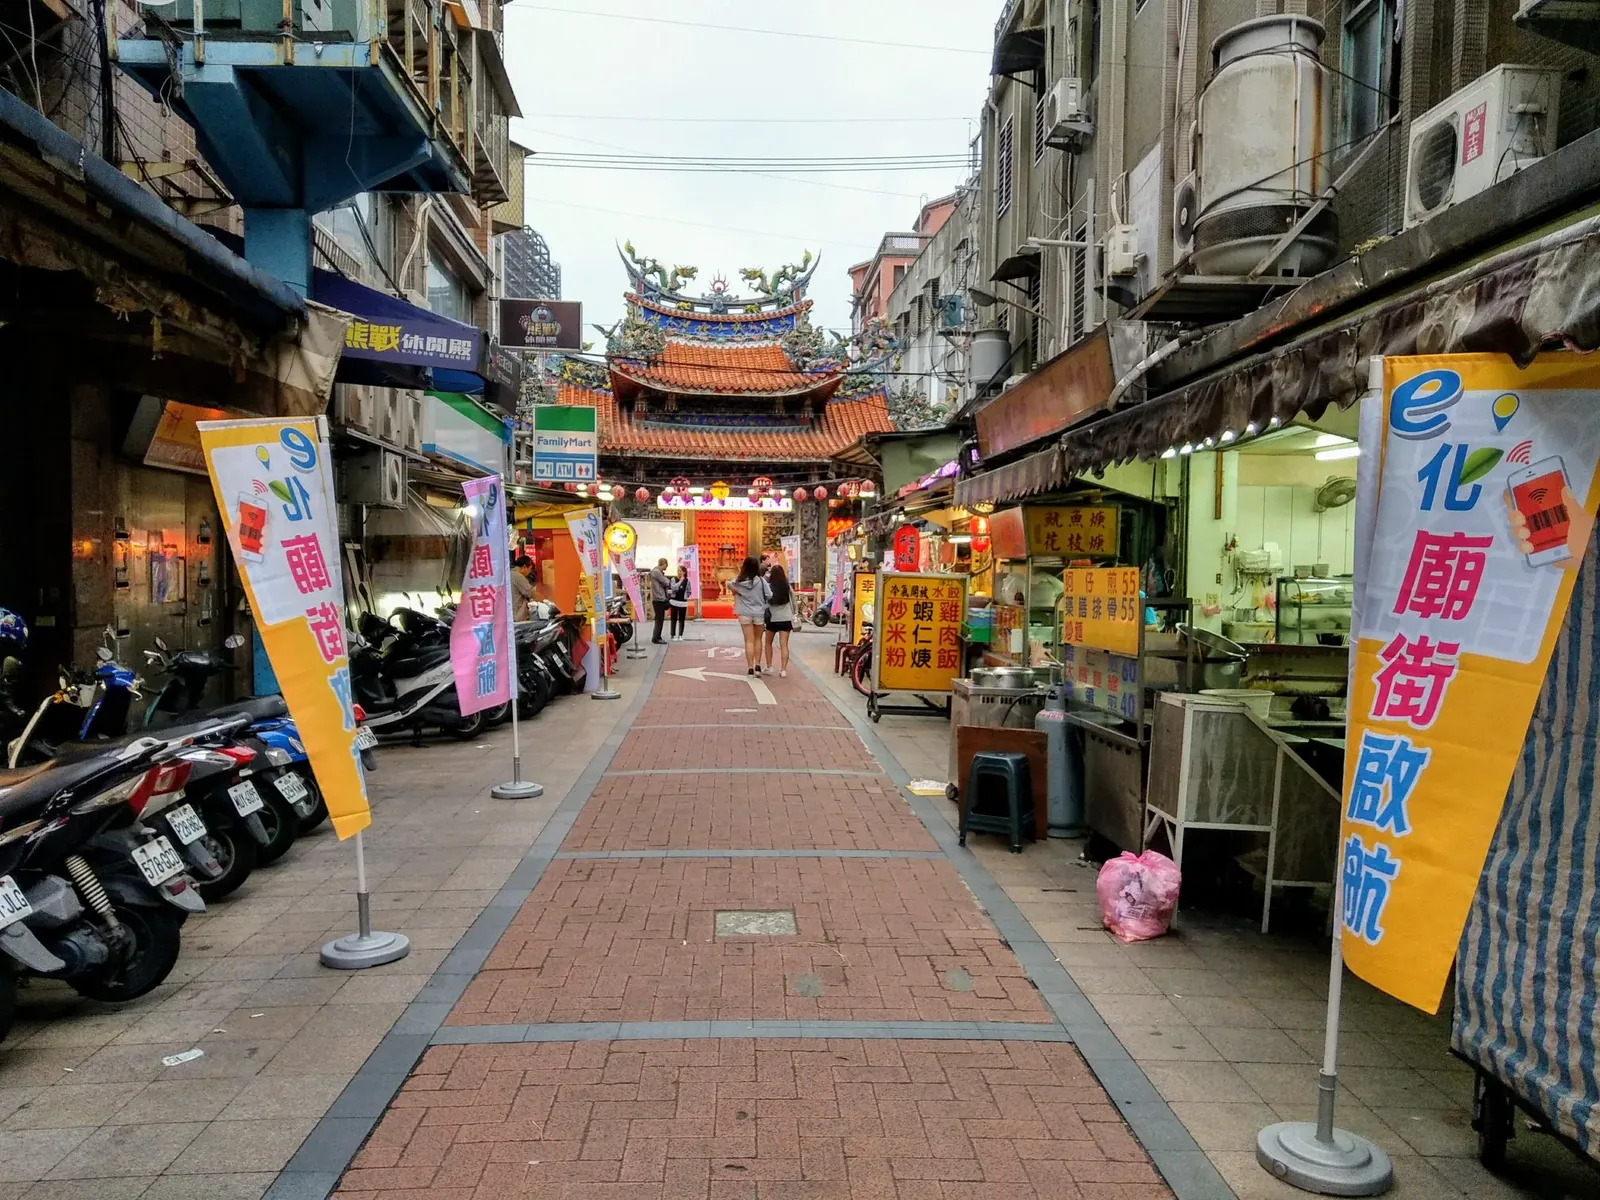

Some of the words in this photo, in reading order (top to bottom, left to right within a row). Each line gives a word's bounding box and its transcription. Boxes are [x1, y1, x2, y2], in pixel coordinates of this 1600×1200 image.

[537, 436, 592, 448] FamilyMart
[556, 464, 573, 477] ATM
[1122, 571, 1136, 595] 55
[1121, 596, 1135, 621] 55
[886, 600, 908, 668] 炒米粉
[937, 601, 960, 670] 雞肉飯
[1121, 692, 1135, 717] 40
